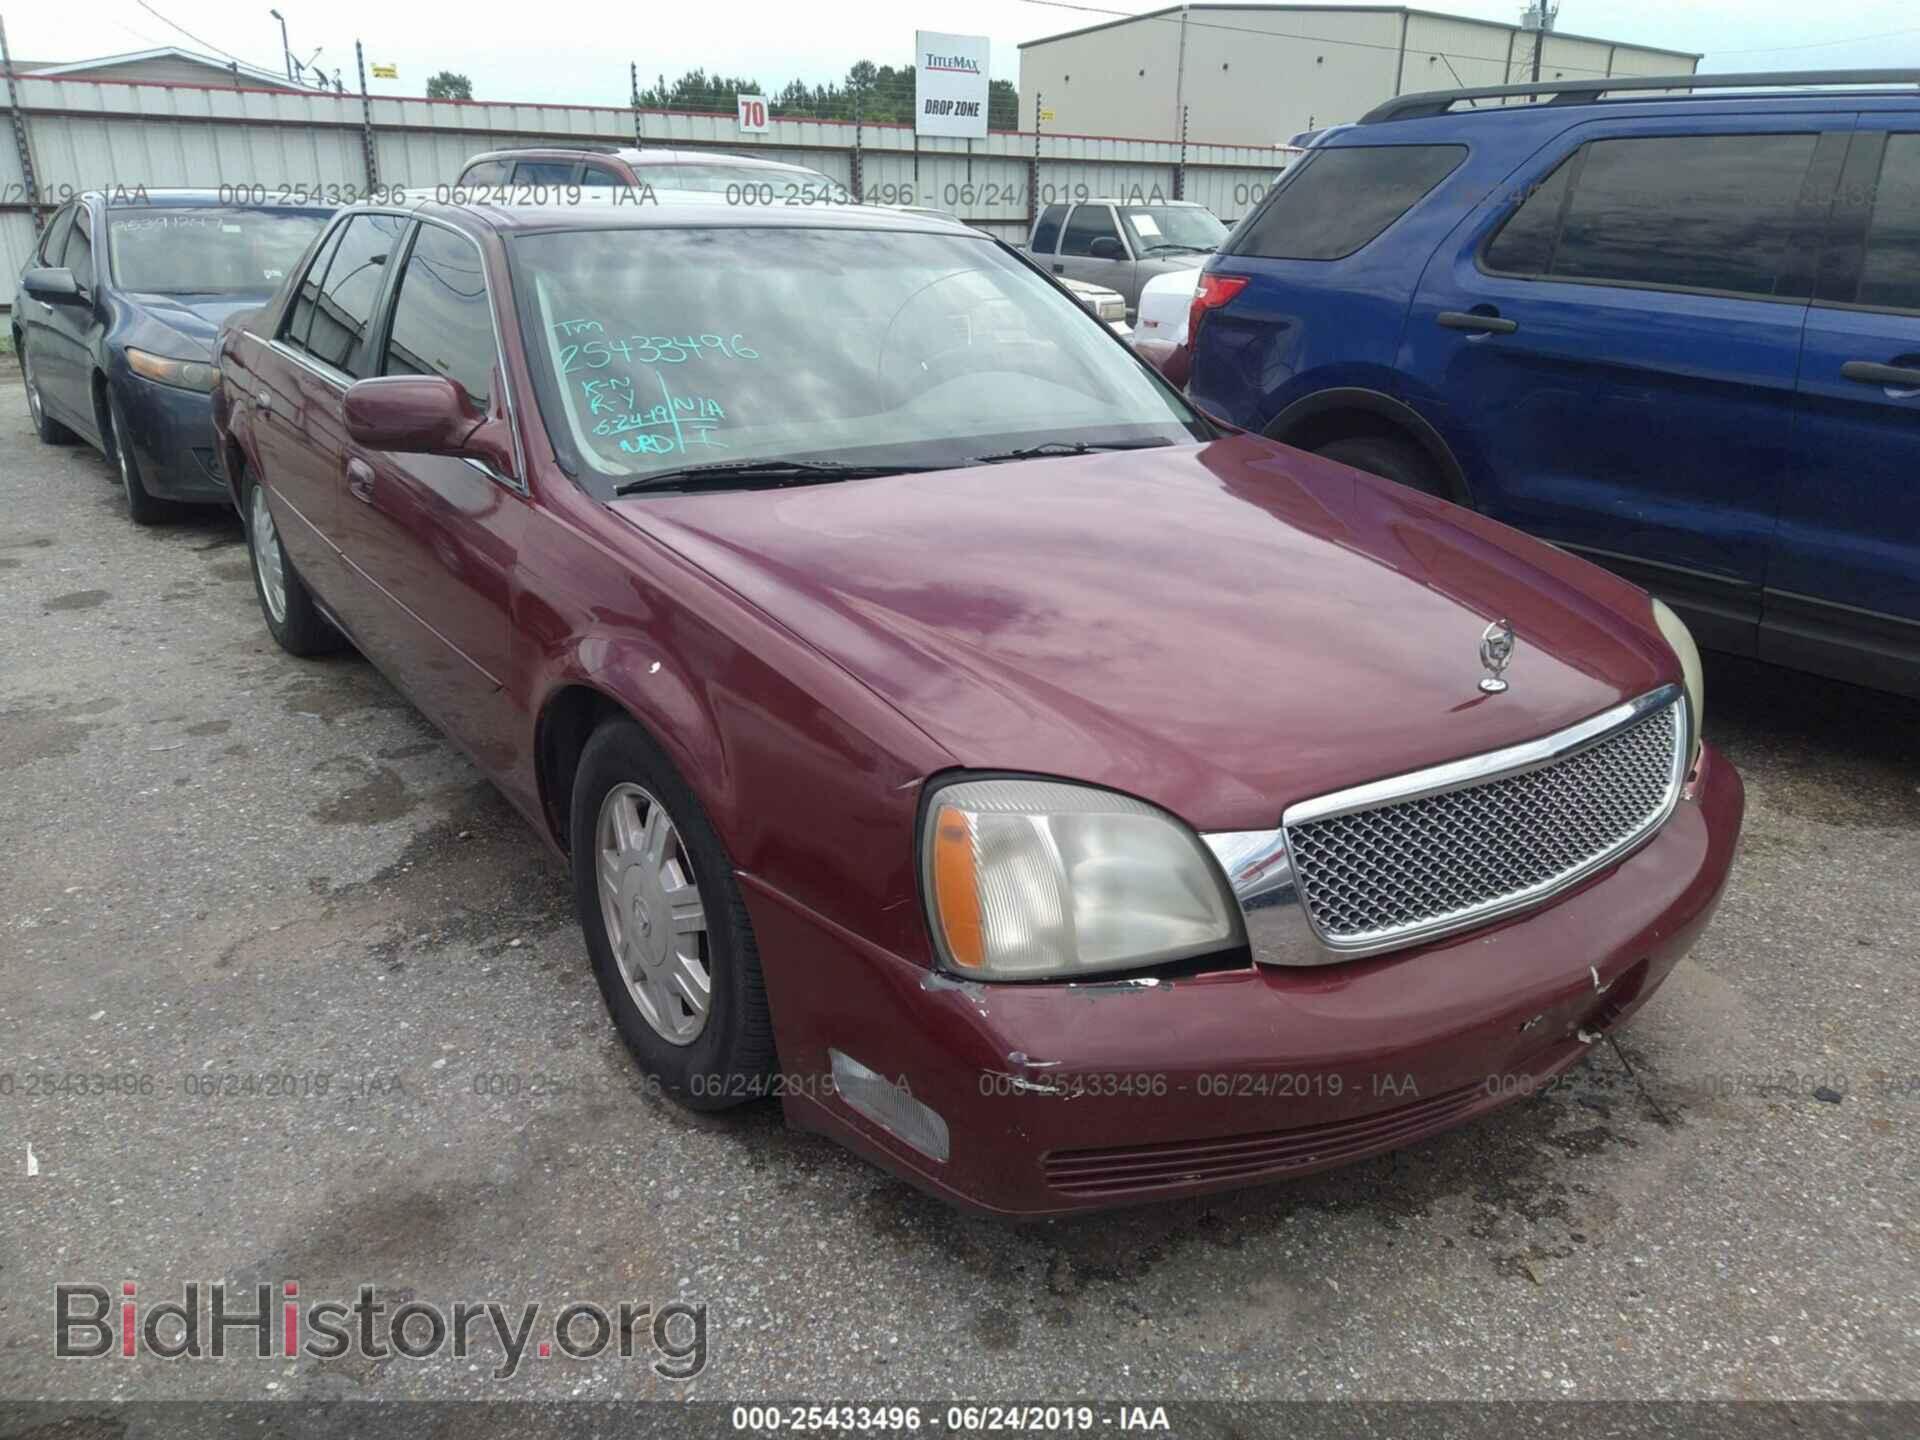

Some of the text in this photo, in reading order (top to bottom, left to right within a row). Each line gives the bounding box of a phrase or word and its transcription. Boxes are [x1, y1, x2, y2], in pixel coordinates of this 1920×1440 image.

[741, 101, 765, 128] 70
[925, 99, 980, 117] DROP ZONE
[560, 335, 759, 375] 25433496
